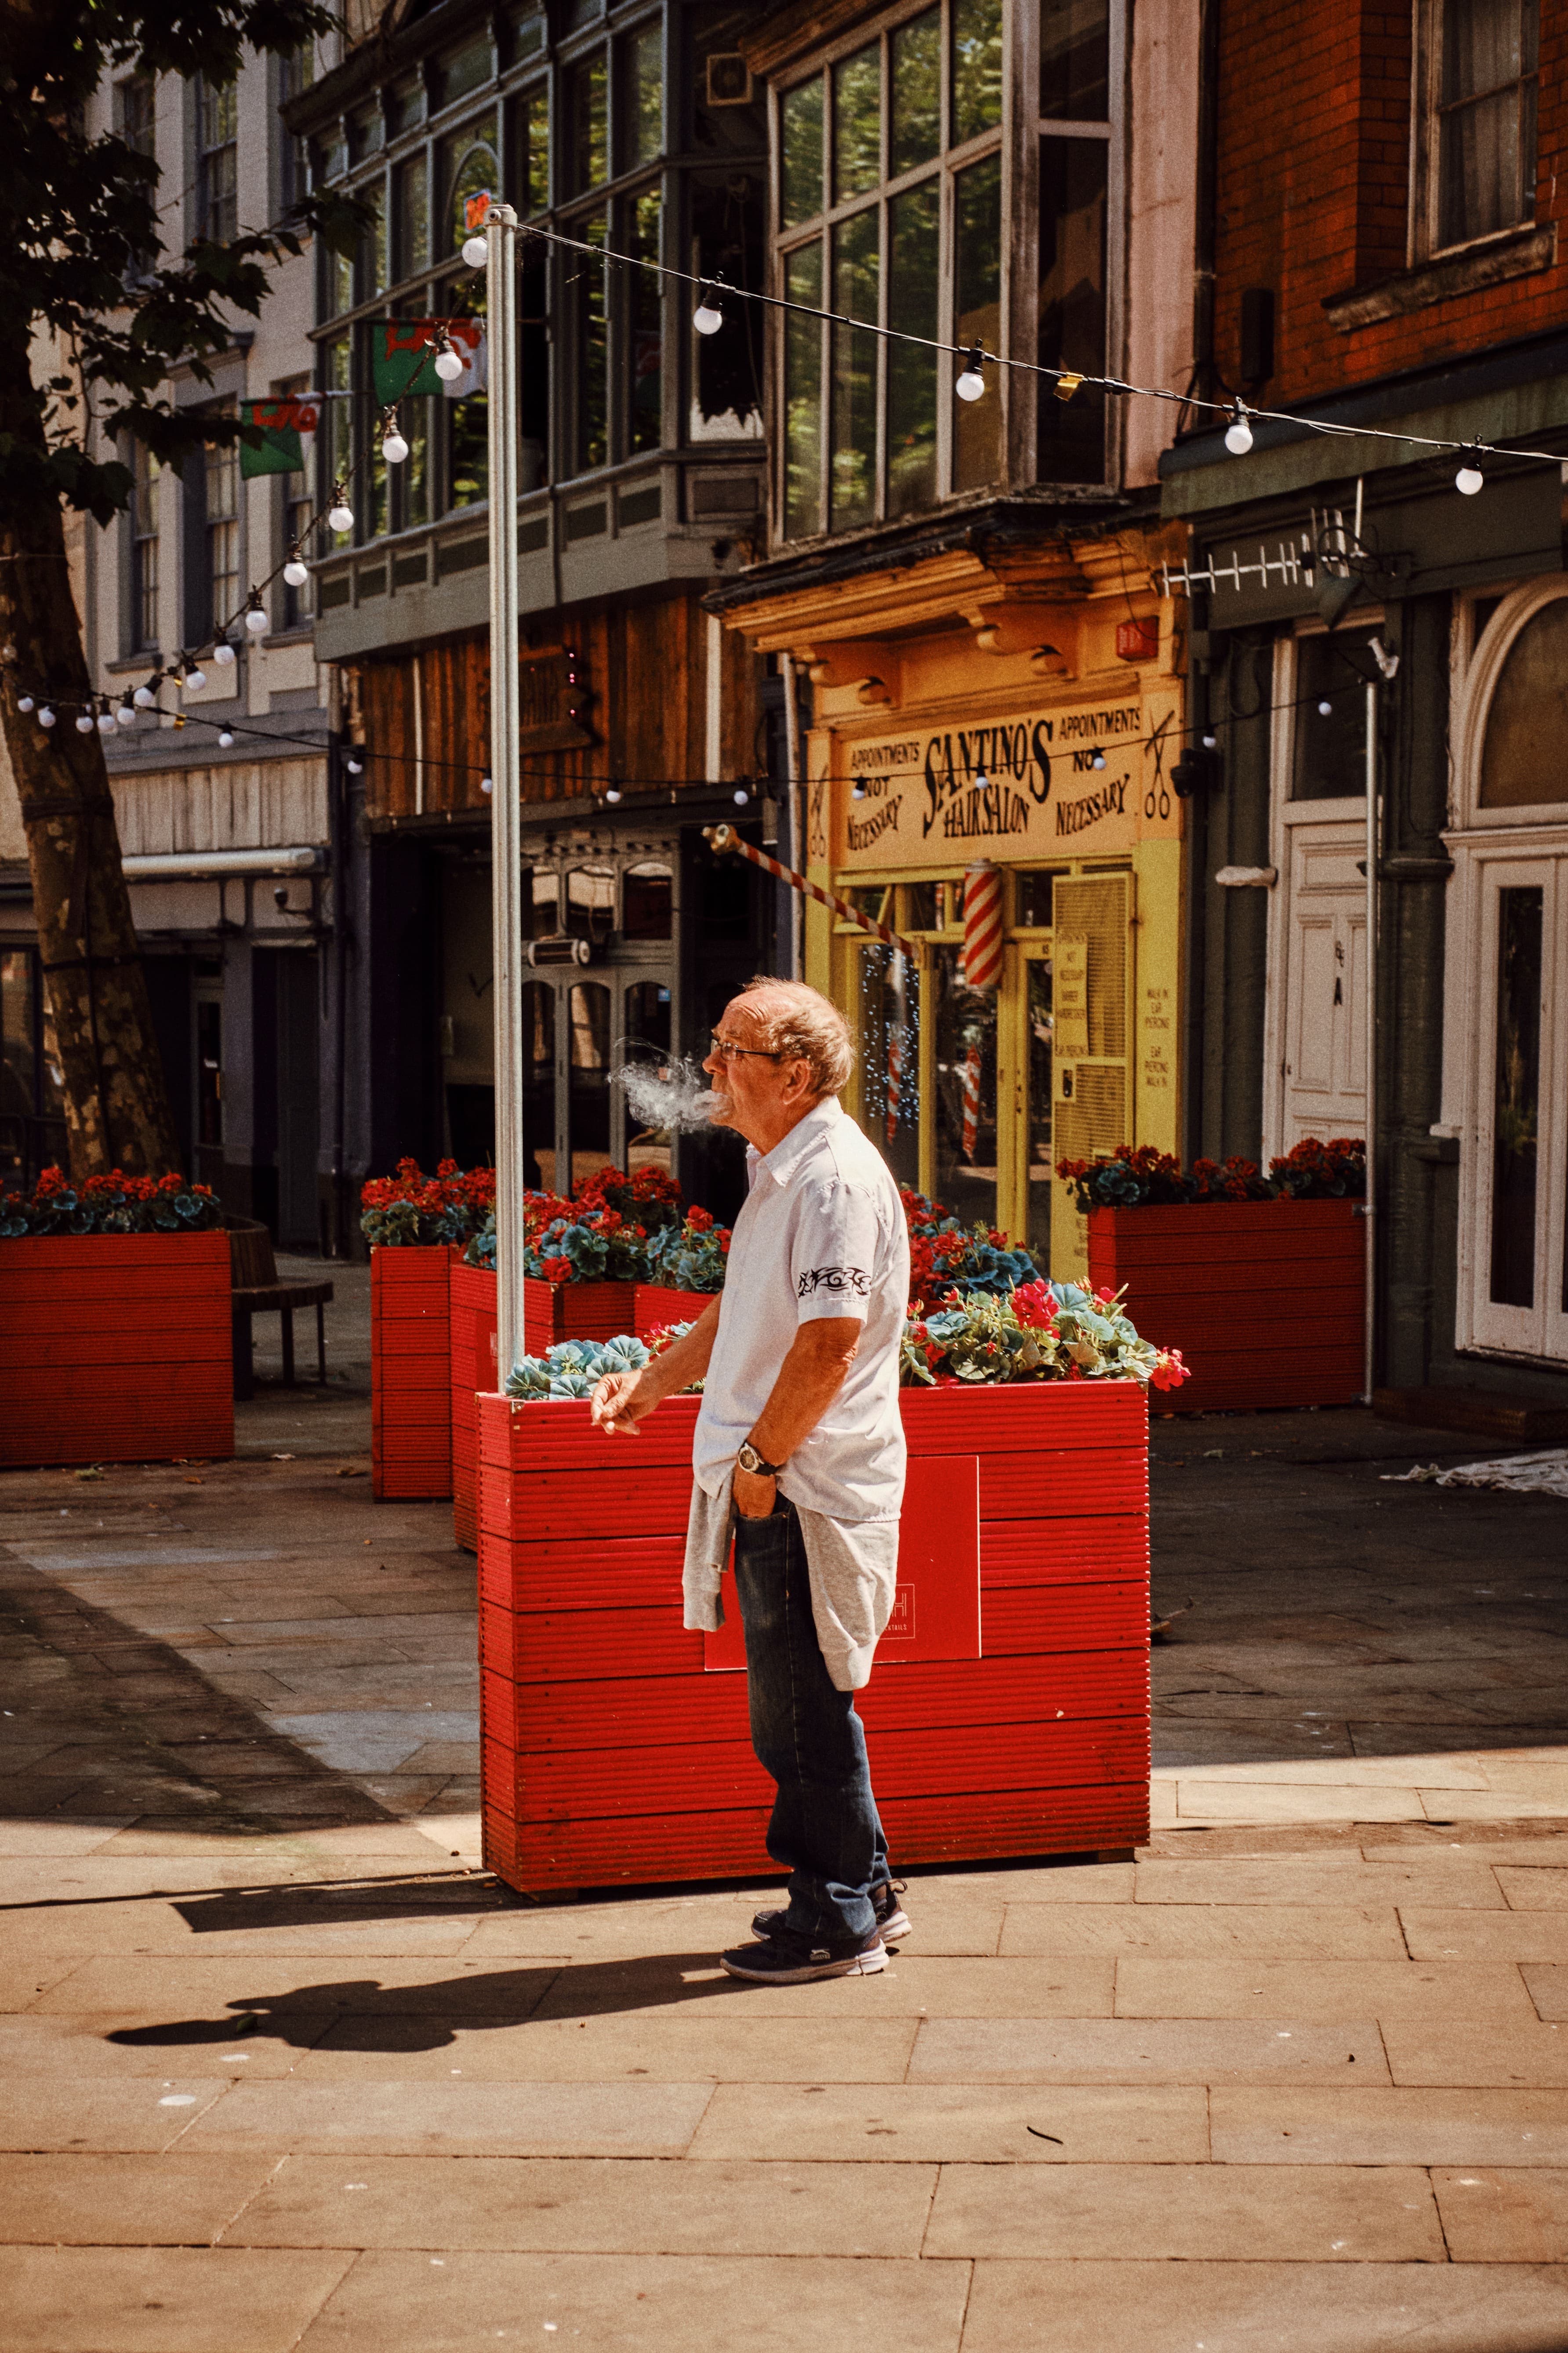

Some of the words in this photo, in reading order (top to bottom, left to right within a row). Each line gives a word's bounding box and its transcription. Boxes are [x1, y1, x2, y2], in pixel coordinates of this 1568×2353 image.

[1060, 708, 1140, 740] APPOINTMENTS
[852, 742, 920, 769] APPOINTMENTS
[1074, 750, 1095, 772] NO
[923, 718, 1053, 839] SANTINO'S
[846, 794, 903, 851] NECESSARY
[1056, 774, 1130, 836] NECESSARY
